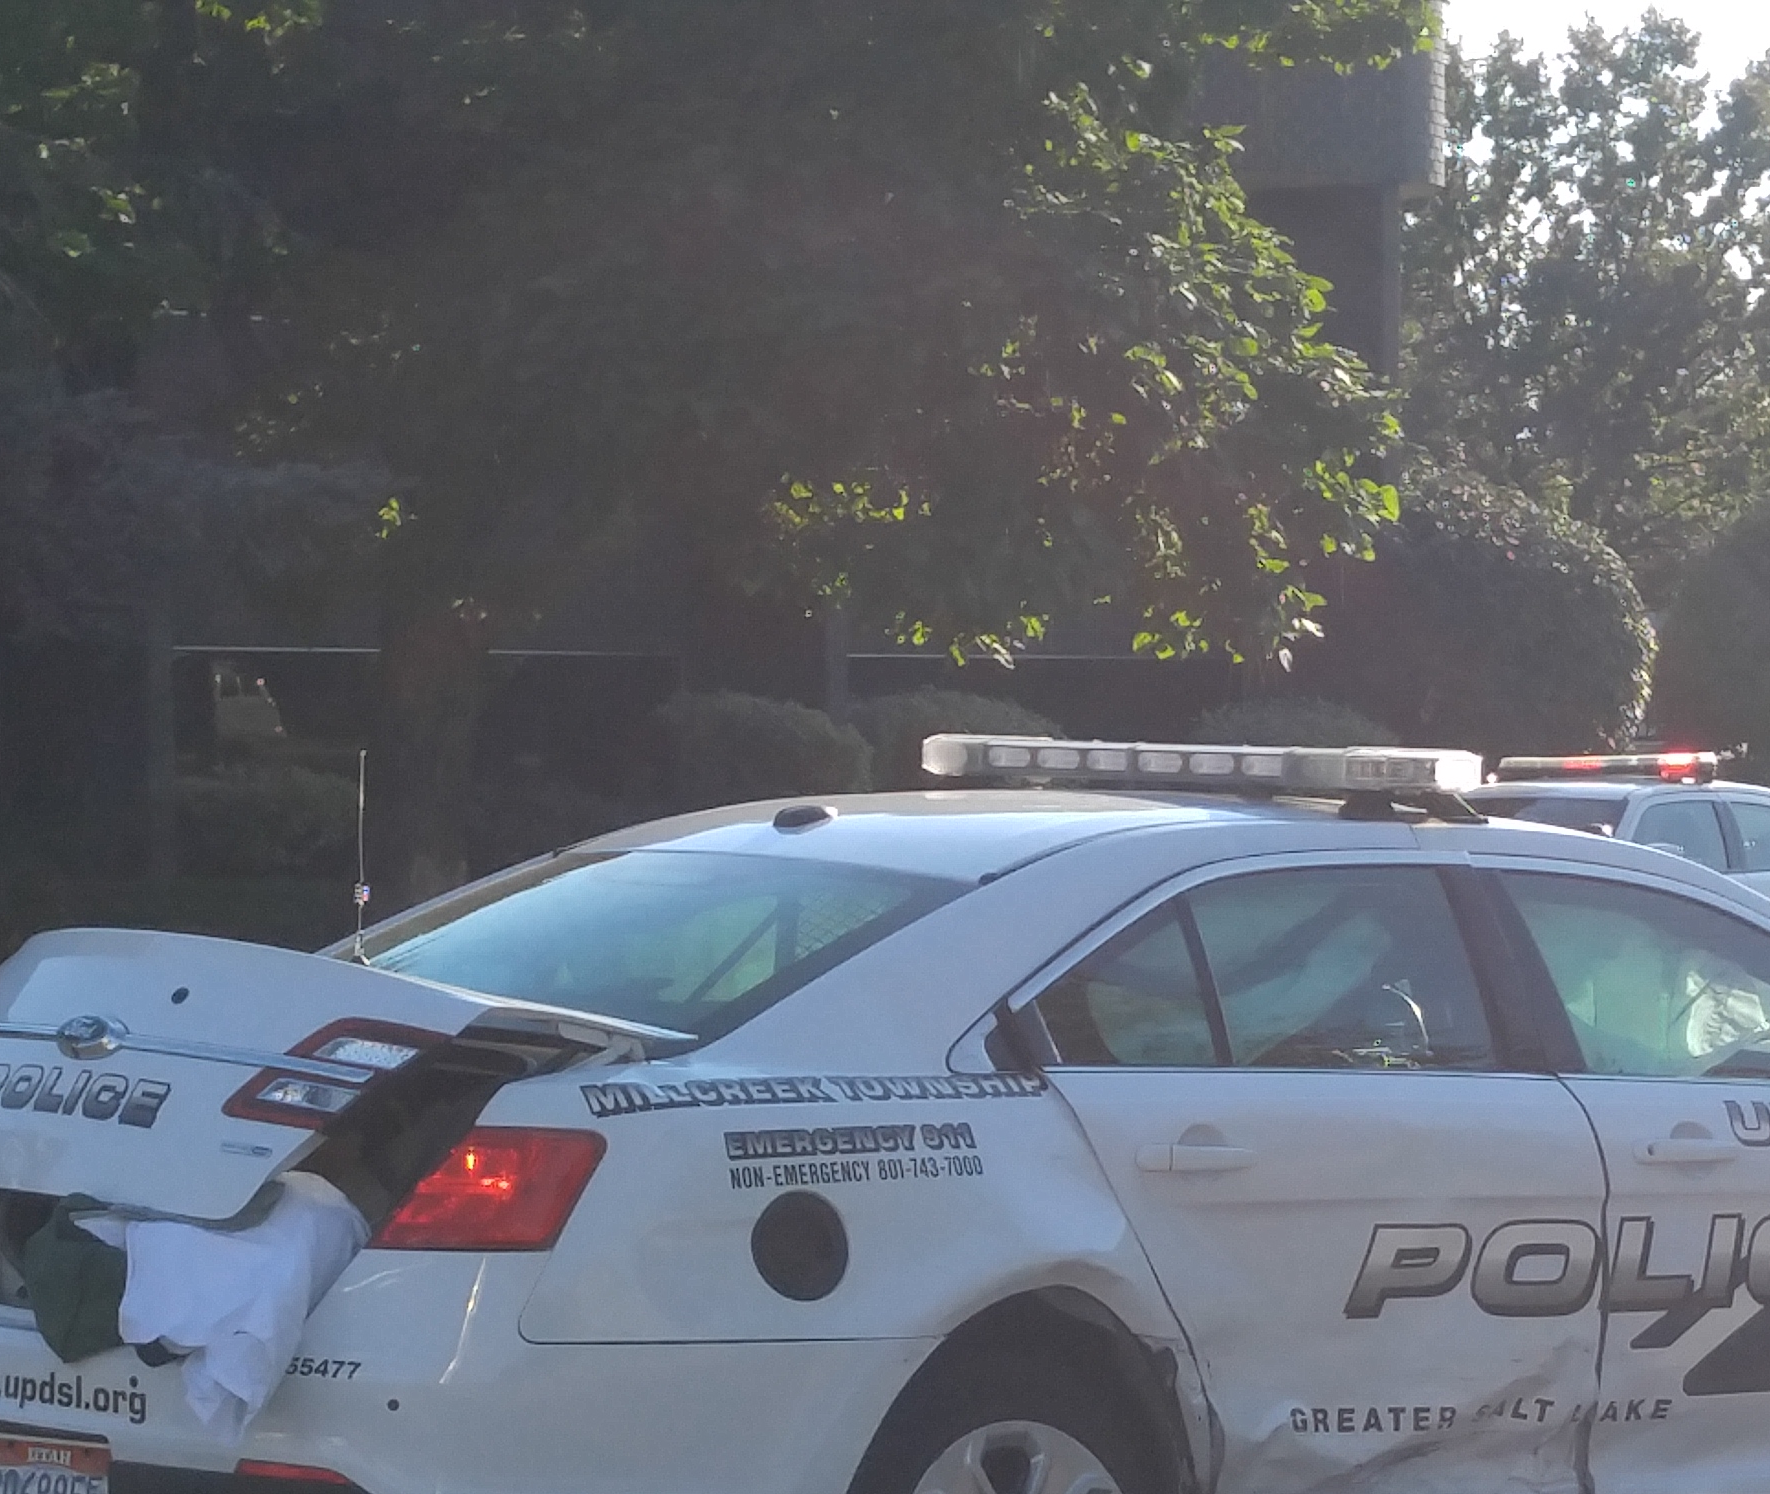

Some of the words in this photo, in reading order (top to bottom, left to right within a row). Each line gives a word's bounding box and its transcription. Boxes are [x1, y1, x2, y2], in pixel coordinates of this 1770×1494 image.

[579, 1077, 837, 1118] MILLCREEK
[827, 1072, 1051, 1103] TOWNSHIP
[723, 1124, 917, 1161] EMERGENCY
[919, 1122, 978, 1150] 911
[729, 1160, 872, 1190] NON-EMERGENCY
[877, 1155, 984, 1181] 801-743-7000
[1289, 1405, 1458, 1434] GREATER
